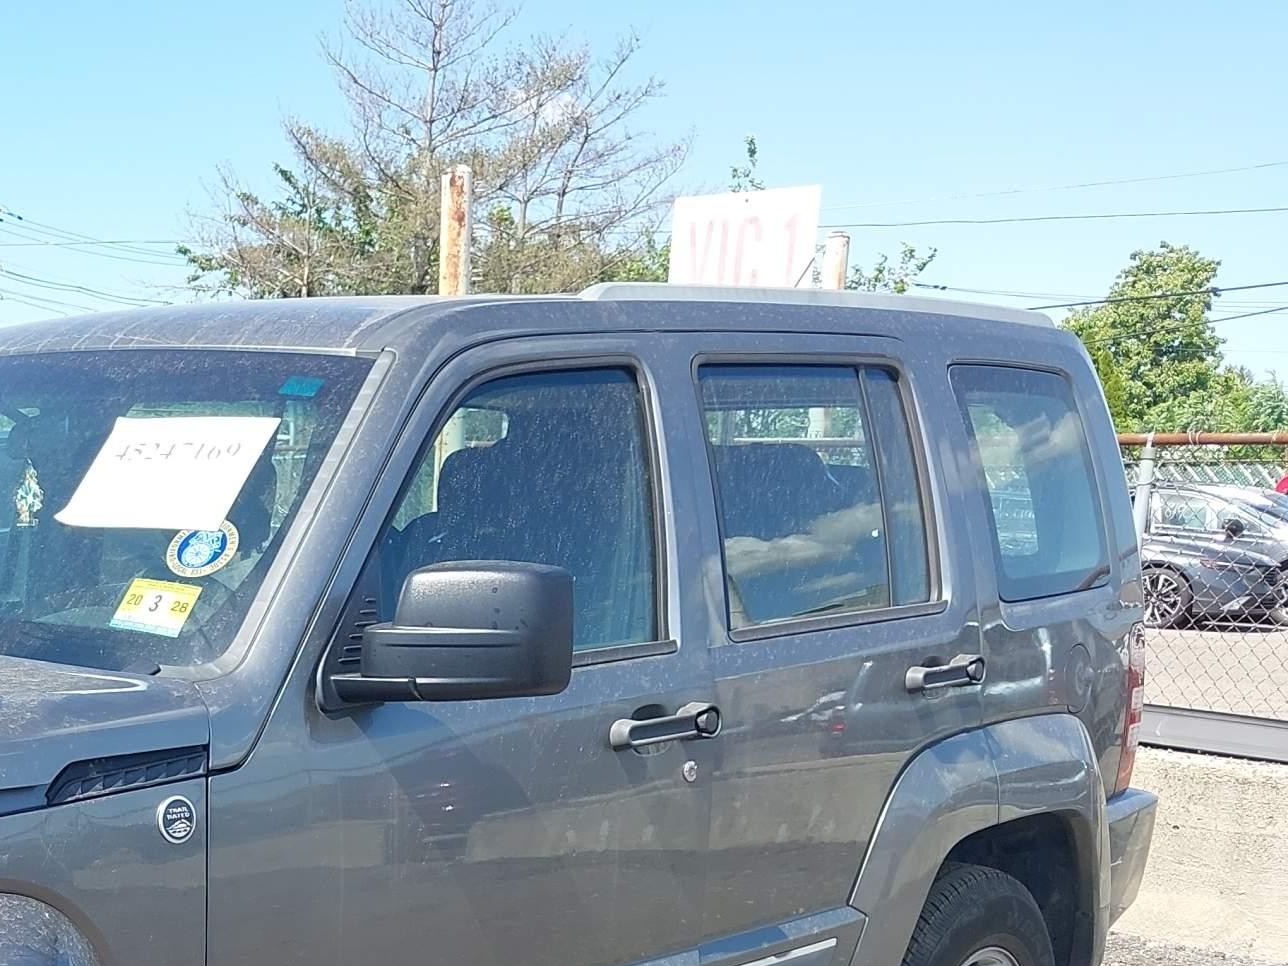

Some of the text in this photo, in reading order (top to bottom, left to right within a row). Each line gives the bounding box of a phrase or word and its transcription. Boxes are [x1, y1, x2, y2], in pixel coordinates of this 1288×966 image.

[127, 593, 189, 613] 20 3 28
